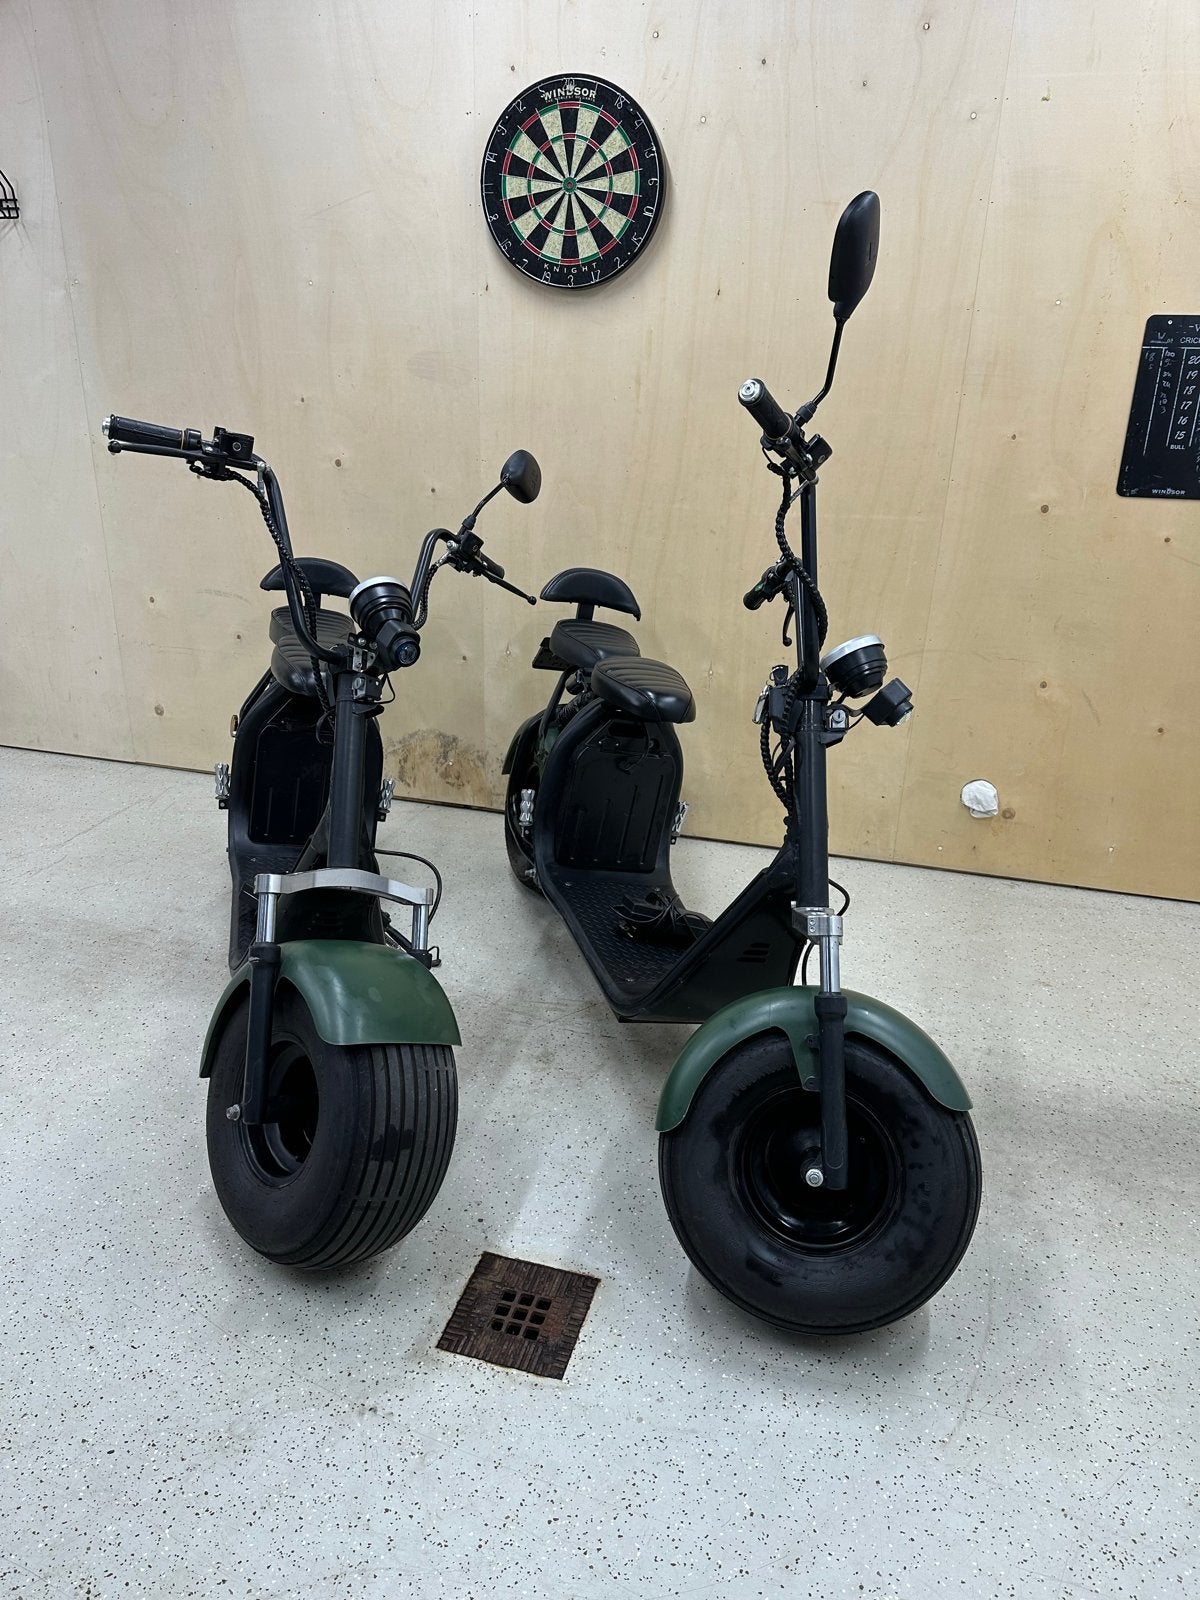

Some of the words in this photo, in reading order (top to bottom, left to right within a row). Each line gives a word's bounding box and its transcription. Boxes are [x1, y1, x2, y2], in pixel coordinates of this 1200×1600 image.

[543, 86, 597, 101] WINDSOR
[513, 99, 527, 113] 12
[614, 93, 626, 110] 18
[634, 119, 645, 130] 4
[486, 152, 498, 163] 14
[643, 146, 656, 159] 13
[484, 182, 495, 195] 11
[489, 213, 499, 223] 8
[500, 238, 512, 251] 16
[631, 231, 643, 246] 15
[521, 258, 529, 269] 7
[543, 262, 597, 274] KNIGHT
[613, 256, 624, 269] 2
[541, 270, 552, 284] 19
[567, 274, 574, 287] 3
[590, 269, 601, 283] 17
[1187, 355, 1200, 365] 20
[1185, 370, 1199, 380] 19
[1183, 385, 1197, 395] 18
[1180, 400, 1193, 410] 17
[1177, 415, 1189, 425] 16
[1174, 430, 1187, 440] 15
[1151, 487, 1186, 496] WINDSOR
